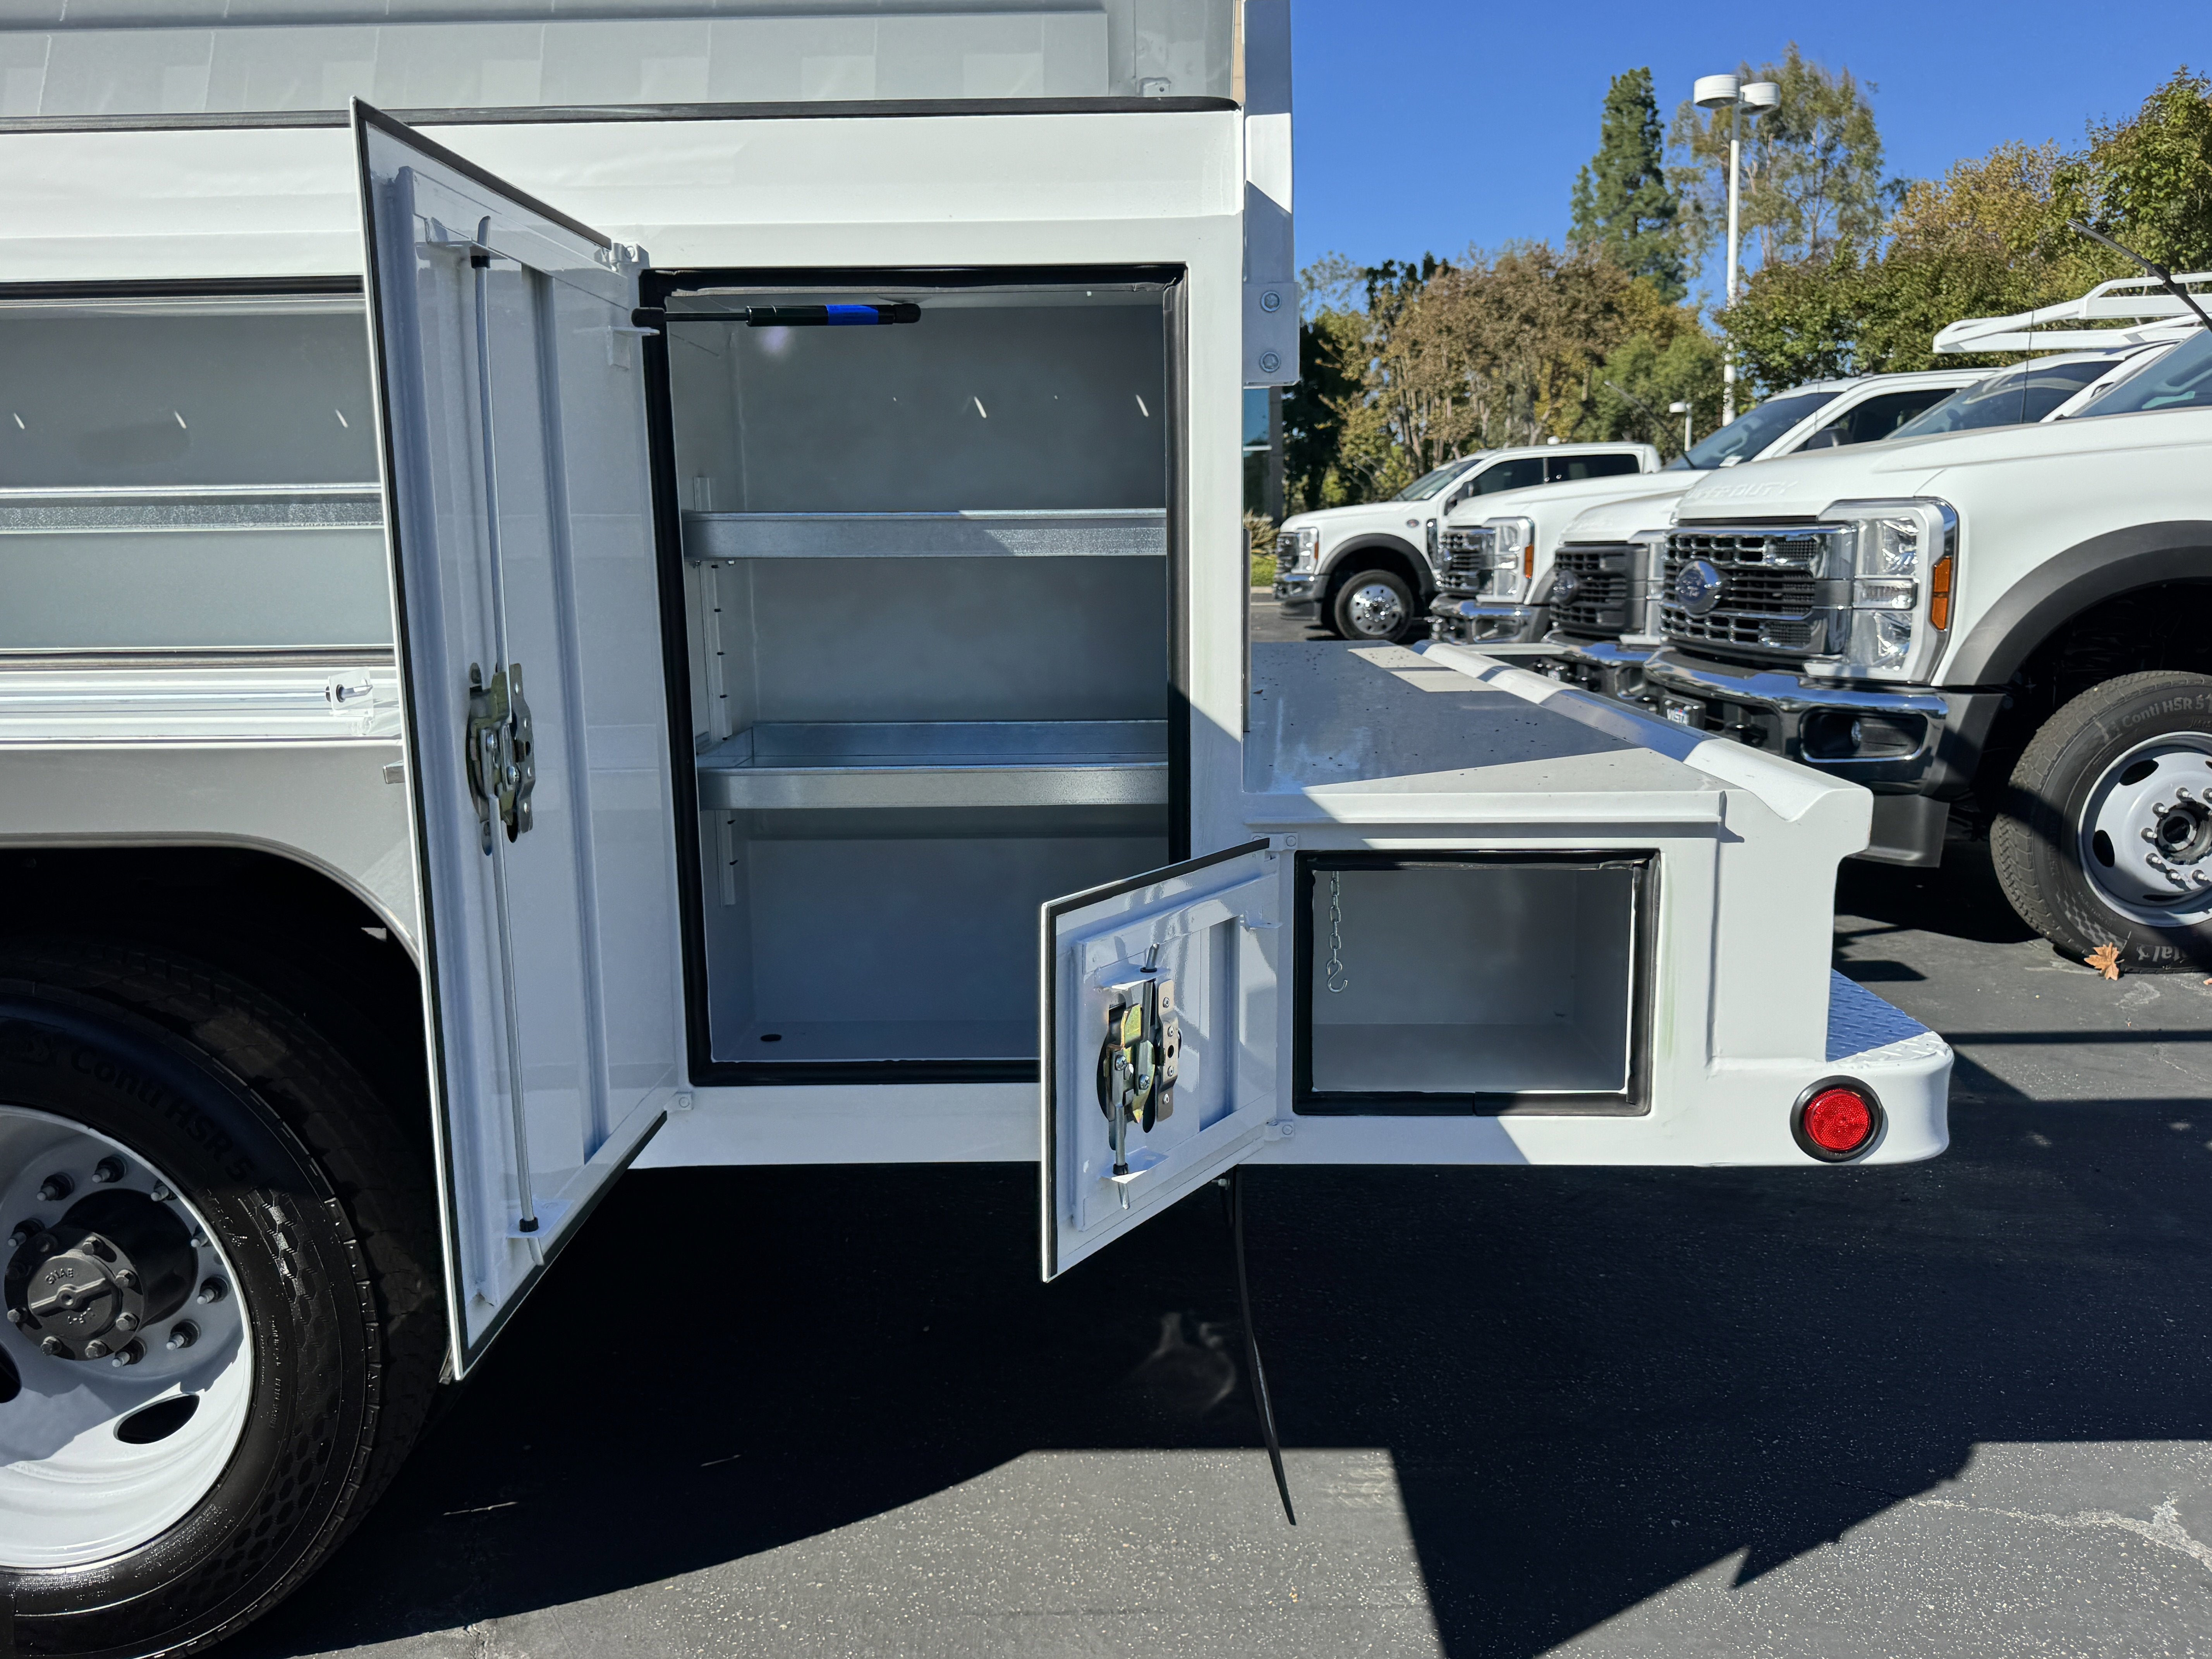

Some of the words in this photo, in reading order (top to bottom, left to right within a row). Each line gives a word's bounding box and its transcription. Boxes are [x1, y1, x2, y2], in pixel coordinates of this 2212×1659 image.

[2122, 702, 2160, 727] Conti
[2162, 697, 2193, 713] HSR
[71, 1046, 167, 1109] Conti
[164, 1097, 234, 1162] HSR
